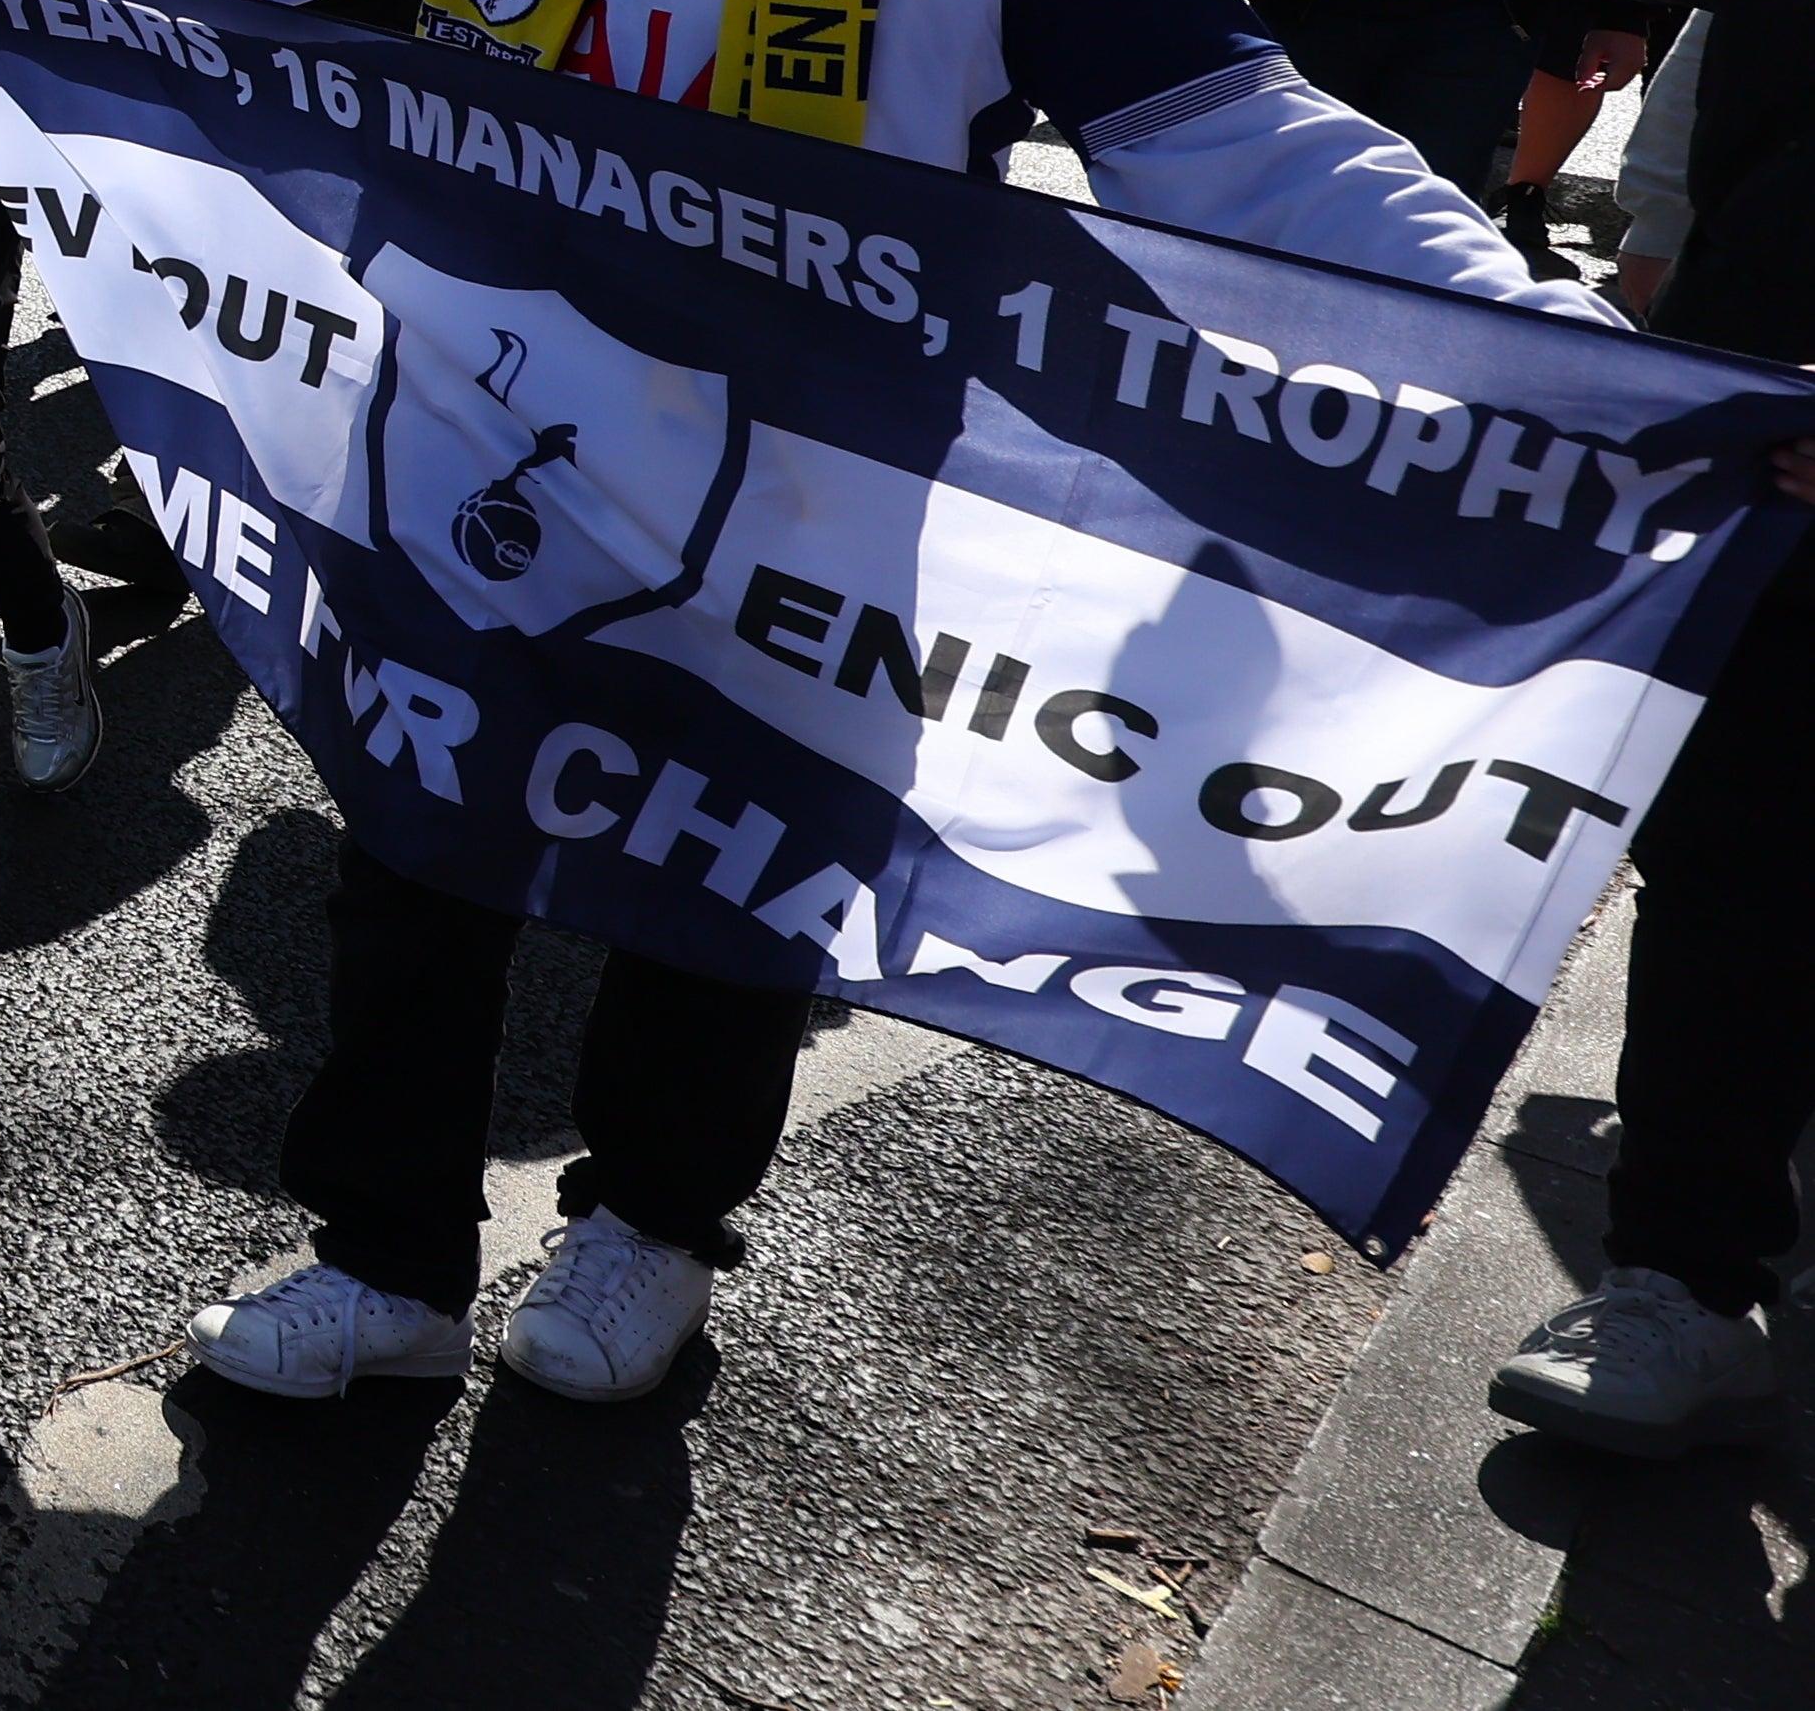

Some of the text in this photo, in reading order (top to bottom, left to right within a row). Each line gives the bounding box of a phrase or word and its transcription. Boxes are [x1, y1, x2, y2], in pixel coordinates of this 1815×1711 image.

[434, 21, 481, 49] EST
[273, 49, 362, 129] 16
[383, 77, 951, 357] MANAGERS,
[998, 280, 1054, 373] 1
[122, 443, 277, 616] ME
[732, 562, 1630, 863] ENIC OUT
